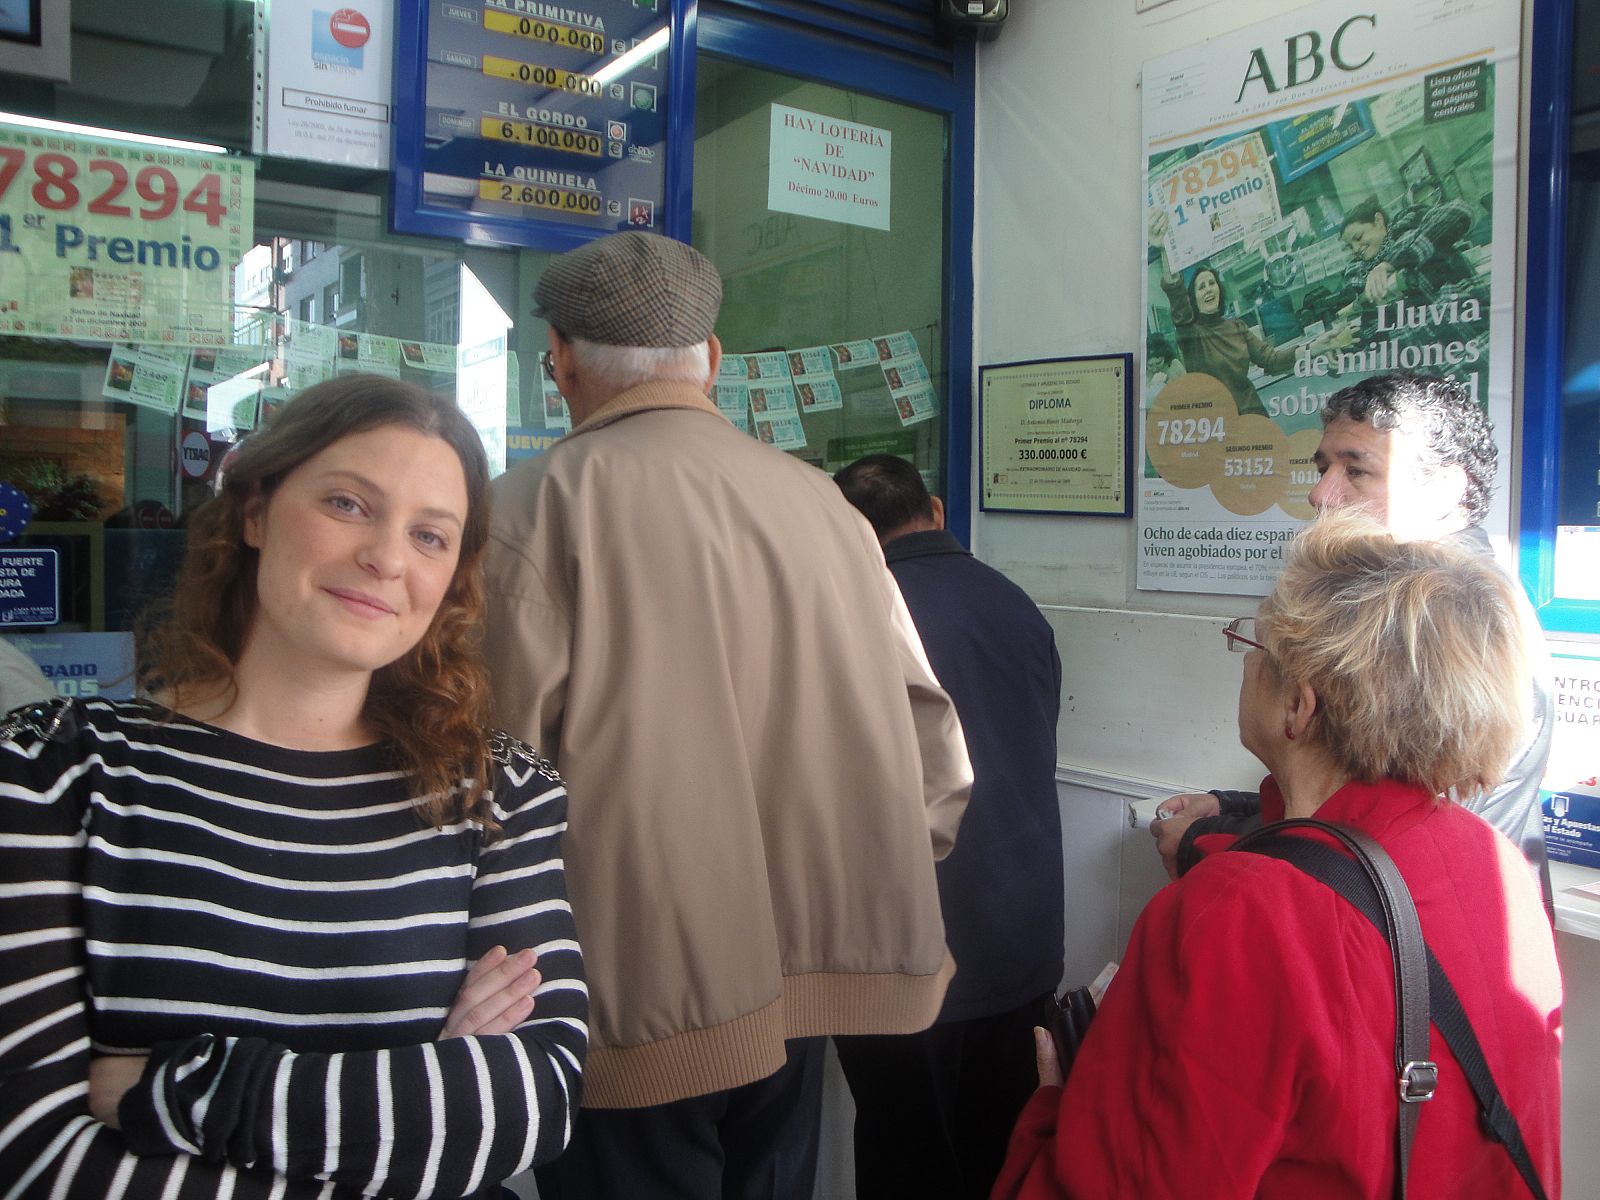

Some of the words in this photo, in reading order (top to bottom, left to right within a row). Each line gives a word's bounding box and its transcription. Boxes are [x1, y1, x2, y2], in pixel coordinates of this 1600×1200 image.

[514, 0, 605, 30] PRIMITIVA
[1234, 14, 1377, 104] ABC
[1430, 76, 1452, 88] Lista
[1452, 65, 1481, 81] oficial
[1431, 99, 1443, 108] en
[1443, 89, 1479, 105] páginas
[1432, 86, 1447, 97] del
[1447, 80, 1477, 93] sorteo
[304, 95, 342, 110] Prohibido
[343, 102, 367, 114] fumar
[498, 101, 519, 117] EL
[526, 107, 588, 128] GORDO
[1433, 101, 1475, 118] centrales
[784, 113, 816, 132] HAY
[820, 122, 884, 148] LOTERÍA
[824, 142, 845, 158] DE
[484, 161, 506, 176] LA
[513, 166, 597, 190] QUINIELA
[1162, 142, 1258, 205] 78294
[0, 146, 228, 227] 78294
[788, 181, 822, 197] Décimo
[825, 188, 848, 201] 20,00
[853, 193, 879, 207] Euros
[1198, 176, 1264, 214] Premio
[501, 184, 601, 212] 2.600.000
[55, 223, 221, 271] Premio
[1375, 293, 1482, 333] Lluvia
[1294, 343, 1330, 378] de
[1336, 336, 1481, 375] millones
[1028, 397, 1072, 410] DIPLOMA
[1169, 403, 1190, 411] PRIMER
[1191, 401, 1213, 410] PREMIO
[1268, 386, 1335, 418] sobr
[1014, 437, 1033, 445] Primer
[1033, 436, 1052, 444] Premio
[1054, 436, 1060, 444] al
[1069, 435, 1088, 444] 78294
[1156, 416, 1226, 446] 78294
[1018, 449, 1078, 460] 330.000.000
[1080, 448, 1088, 460] €
[1225, 445, 1251, 453] SEGUNDO
[1223, 457, 1274, 478] 53152
[1289, 470, 1322, 485] 1010
[1143, 526, 1175, 541] Ocho
[1176, 526, 1193, 541] de
[1194, 526, 1224, 541] cada
[1228, 526, 1253, 542] diez
[1255, 527, 1299, 545] españ
[2, 557, 45, 567] FUERTE
[1143, 542, 1176, 558] viven
[1178, 543, 1242, 561] agobiados
[1244, 546, 1268, 562] por
[1270, 545, 1283, 560] el
[20, 567, 36, 577] DE
[1551, 825, 1582, 838] Estado
